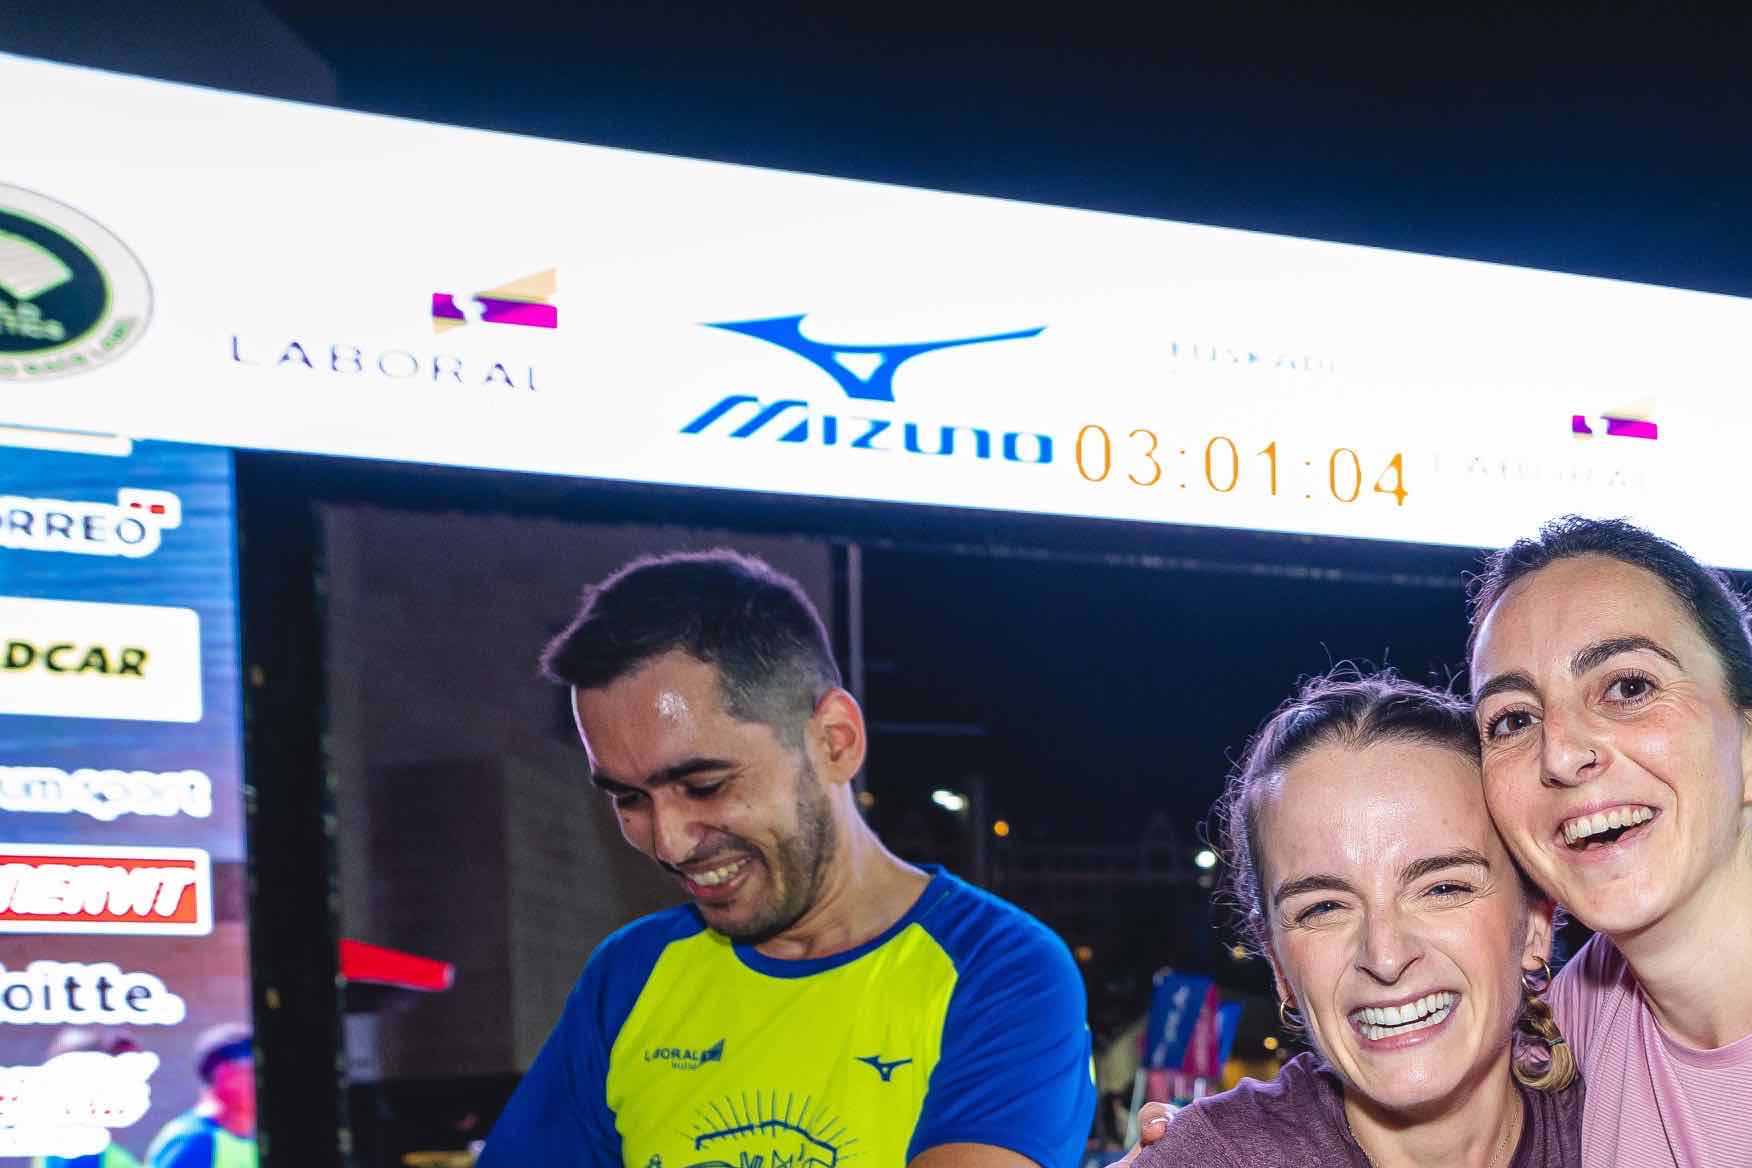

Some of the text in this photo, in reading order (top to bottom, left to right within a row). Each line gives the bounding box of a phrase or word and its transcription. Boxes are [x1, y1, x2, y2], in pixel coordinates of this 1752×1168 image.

[1074, 423, 1410, 507] 03:01:04
[0, 510, 147, 545] RREO
[4, 641, 148, 676] DCAR
[3, 975, 153, 1013] oitte
